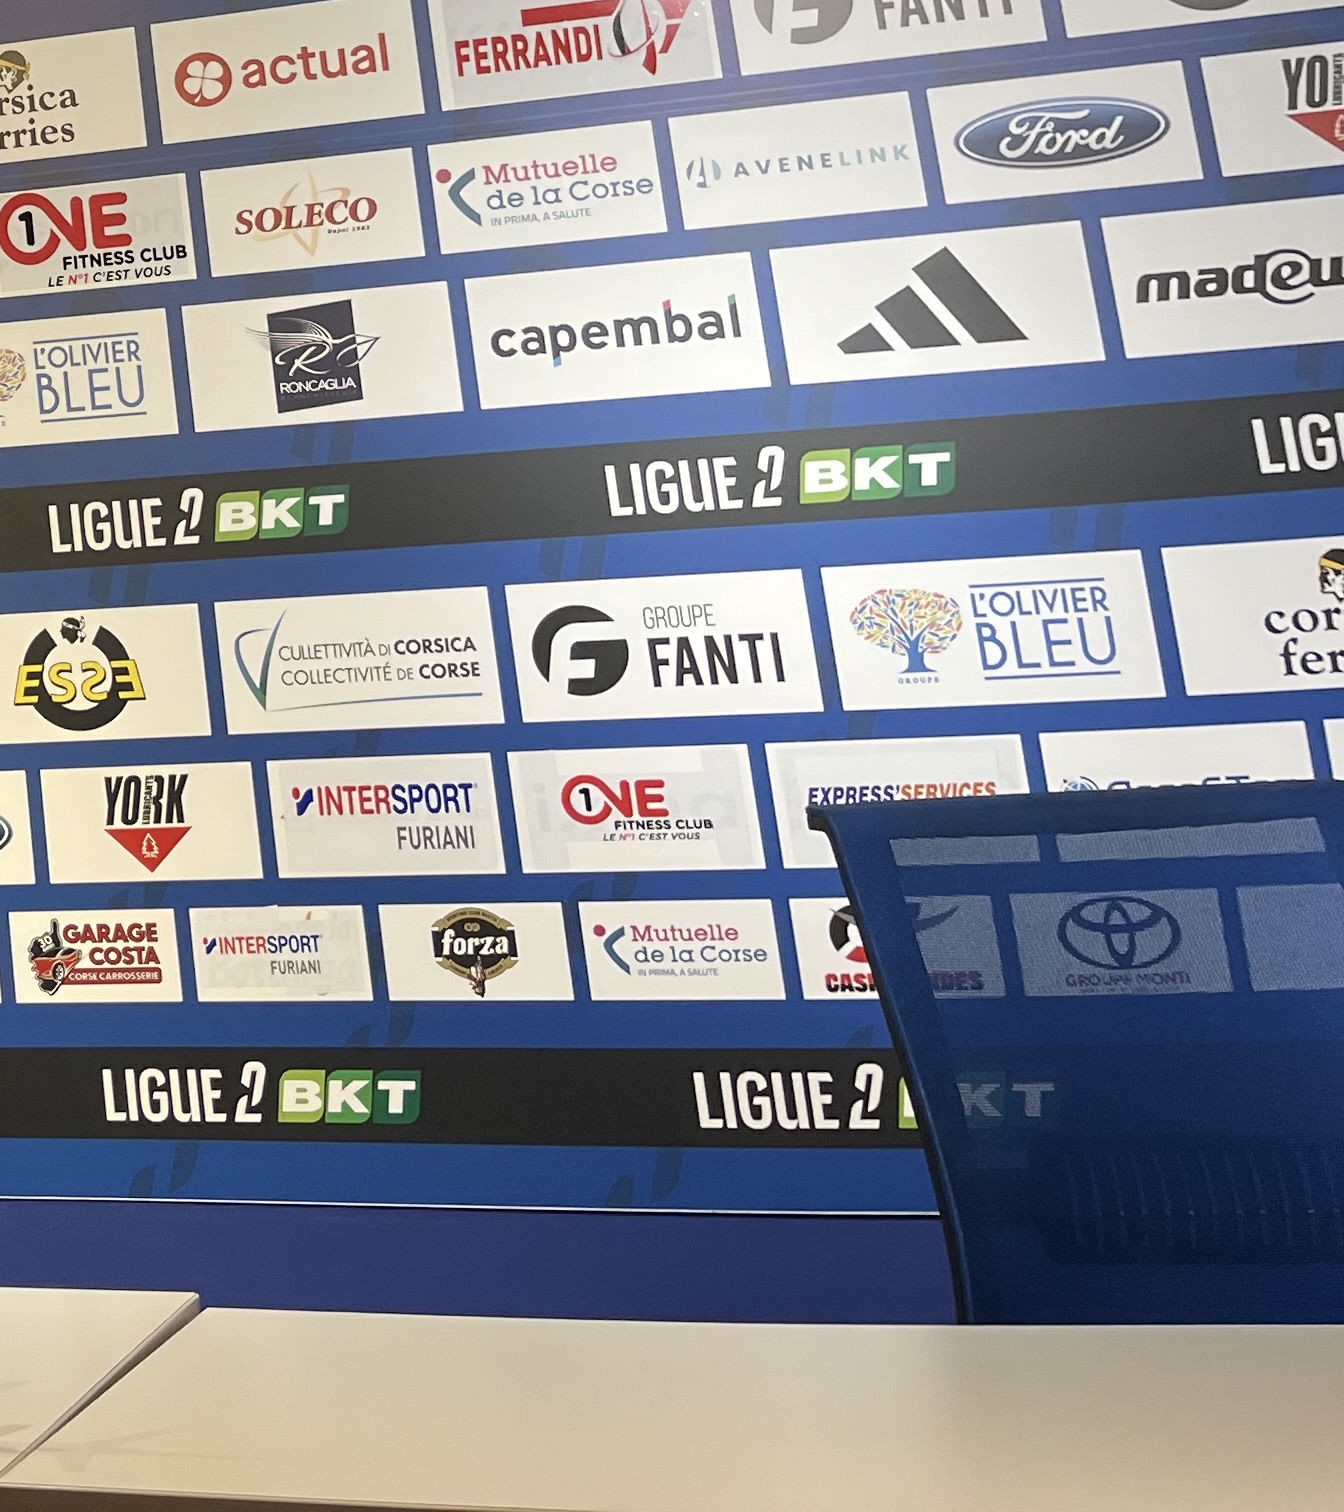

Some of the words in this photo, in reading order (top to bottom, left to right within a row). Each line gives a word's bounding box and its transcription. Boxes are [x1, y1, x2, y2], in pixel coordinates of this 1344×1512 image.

[242, 33, 390, 89] actual
[455, 24, 603, 77] FERRANDI
[999, 109, 1127, 158] Ford
[482, 154, 617, 185] Mutuelle
[734, 144, 910, 178] AVENELINK
[487, 191, 526, 211] de
[532, 188, 560, 205] la
[569, 177, 654, 199] Corse
[235, 197, 377, 235] SOLECO
[491, 217, 501, 226] IN
[553, 208, 592, 220] SALUTE
[63, 251, 134, 270] FITNESS
[140, 245, 187, 261] CLUB
[48, 276, 64, 286] LE
[93, 270, 129, 283] C'EST
[134, 266, 171, 279] VOUS
[490, 293, 742, 368] capembal
[34, 340, 142, 369] L'OLIVIER
[36, 365, 145, 415] BLEU
[280, 377, 356, 394] RONCAGLIA
[604, 456, 744, 518] LIGUE
[752, 445, 785, 508] 2
[804, 452, 950, 493] BKT
[48, 498, 166, 553] LIGUE
[173, 488, 204, 545] 2
[218, 495, 345, 532] BKT
[643, 603, 716, 629] GROUPE
[970, 587, 1109, 618] L'OLIVIER
[278, 638, 376, 661] CULLETTIVITÀ
[378, 643, 391, 656] DI
[394, 636, 477, 655] CORSICA
[976, 616, 1117, 670] BLEU
[281, 663, 392, 686] COLLECTIVITÉ
[397, 668, 414, 681] DE
[419, 662, 480, 679] CORSE
[646, 632, 786, 688] FANTI
[898, 676, 939, 684] GROUPE
[104, 774, 188, 825] YORK
[318, 783, 472, 816] INTERSPORT
[901, 782, 997, 799] SERVICES
[398, 825, 476, 849] FURIANI
[615, 820, 671, 830] FITNESS
[675, 818, 714, 830] CLUB
[671, 832, 700, 841] VOUS
[63, 923, 158, 943] GARAGE
[219, 935, 319, 955] INTERSPORT
[441, 928, 509, 956] forza
[630, 924, 739, 942] Mutuelle
[91, 946, 161, 965] COSTA
[271, 960, 321, 975] FURIANI
[634, 946, 664, 963] de
[669, 946, 695, 962] la
[700, 945, 768, 962] Corse
[69, 972, 97, 982] CORSE
[99, 971, 159, 982] CARROSSERIE
[102, 1069, 227, 1123] LIGUE
[235, 1061, 266, 1123] 2
[282, 1080, 416, 1114] BKT
[693, 1071, 839, 1129] LIGUE
[849, 1063, 883, 1129] 2
